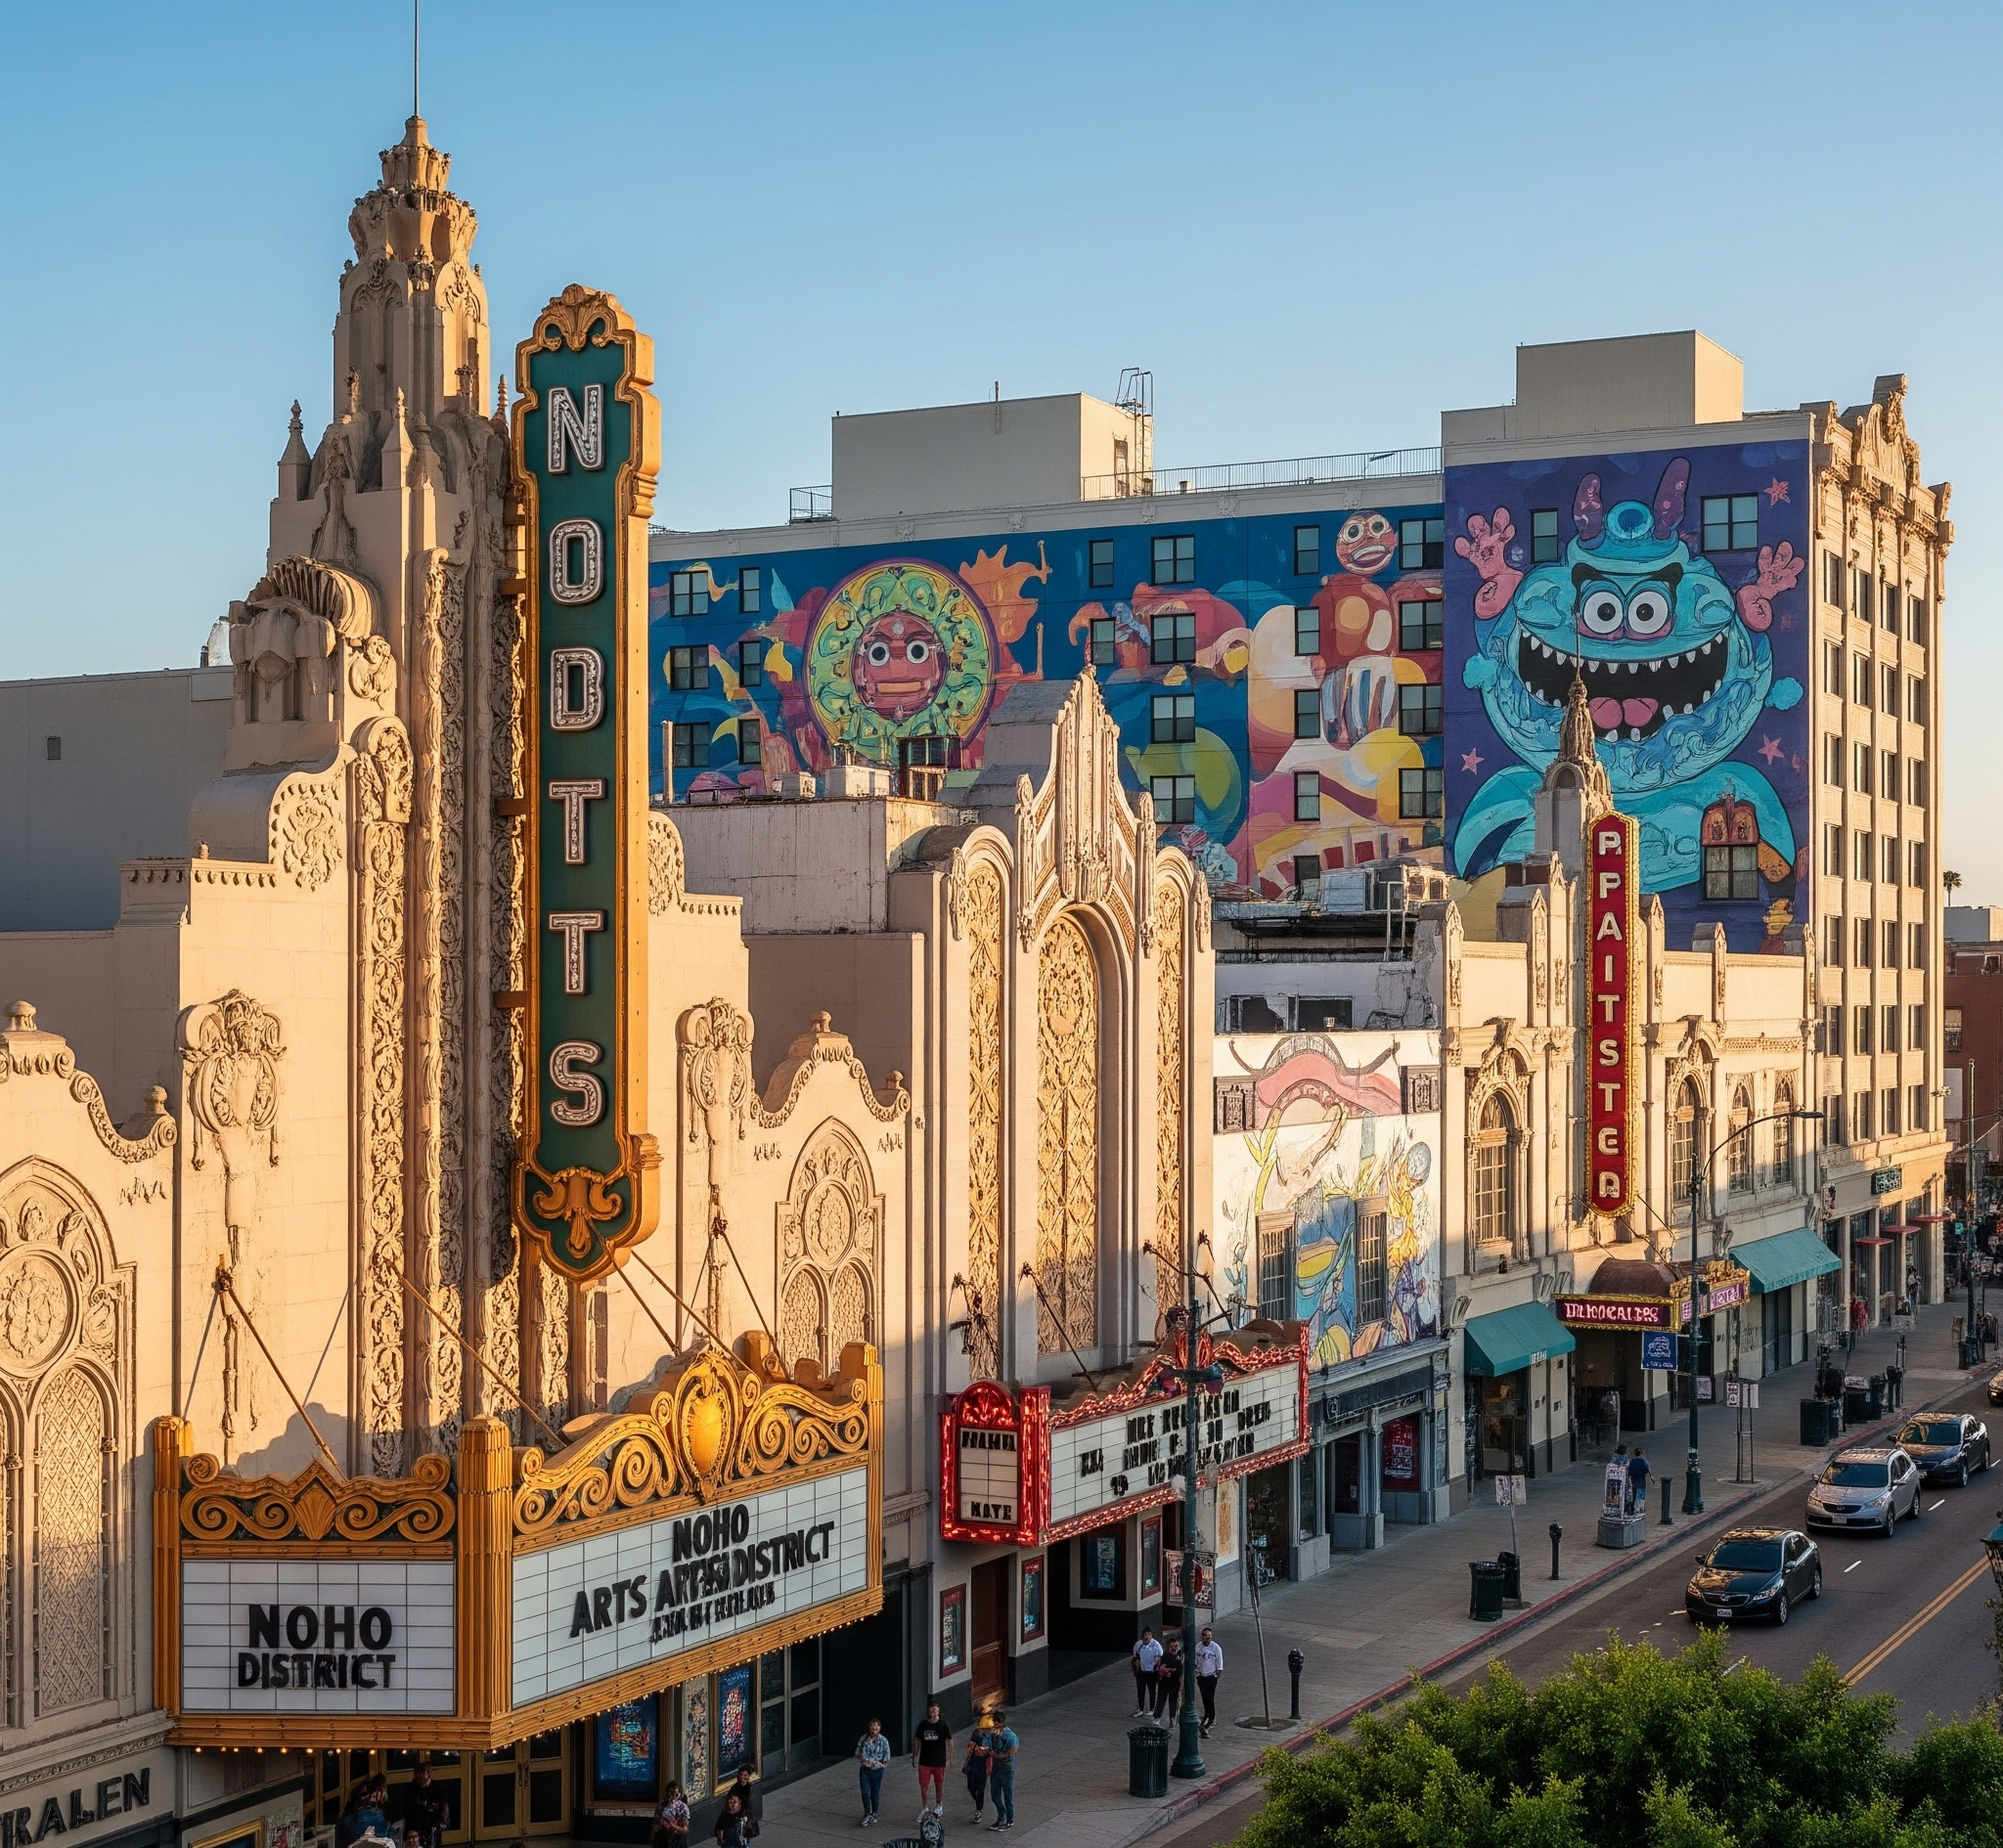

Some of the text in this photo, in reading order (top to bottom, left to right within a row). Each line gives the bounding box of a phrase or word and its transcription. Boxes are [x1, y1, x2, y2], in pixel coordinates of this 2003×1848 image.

[548, 381, 606, 1127] NODTTS
[672, 1503, 750, 1564] NOHO
[569, 1574, 648, 1640] ARTS
[731, 1520, 835, 1589] DISTRICT
[247, 1604, 393, 1650] NOHO
[238, 1651, 396, 1689] DISTRICT
